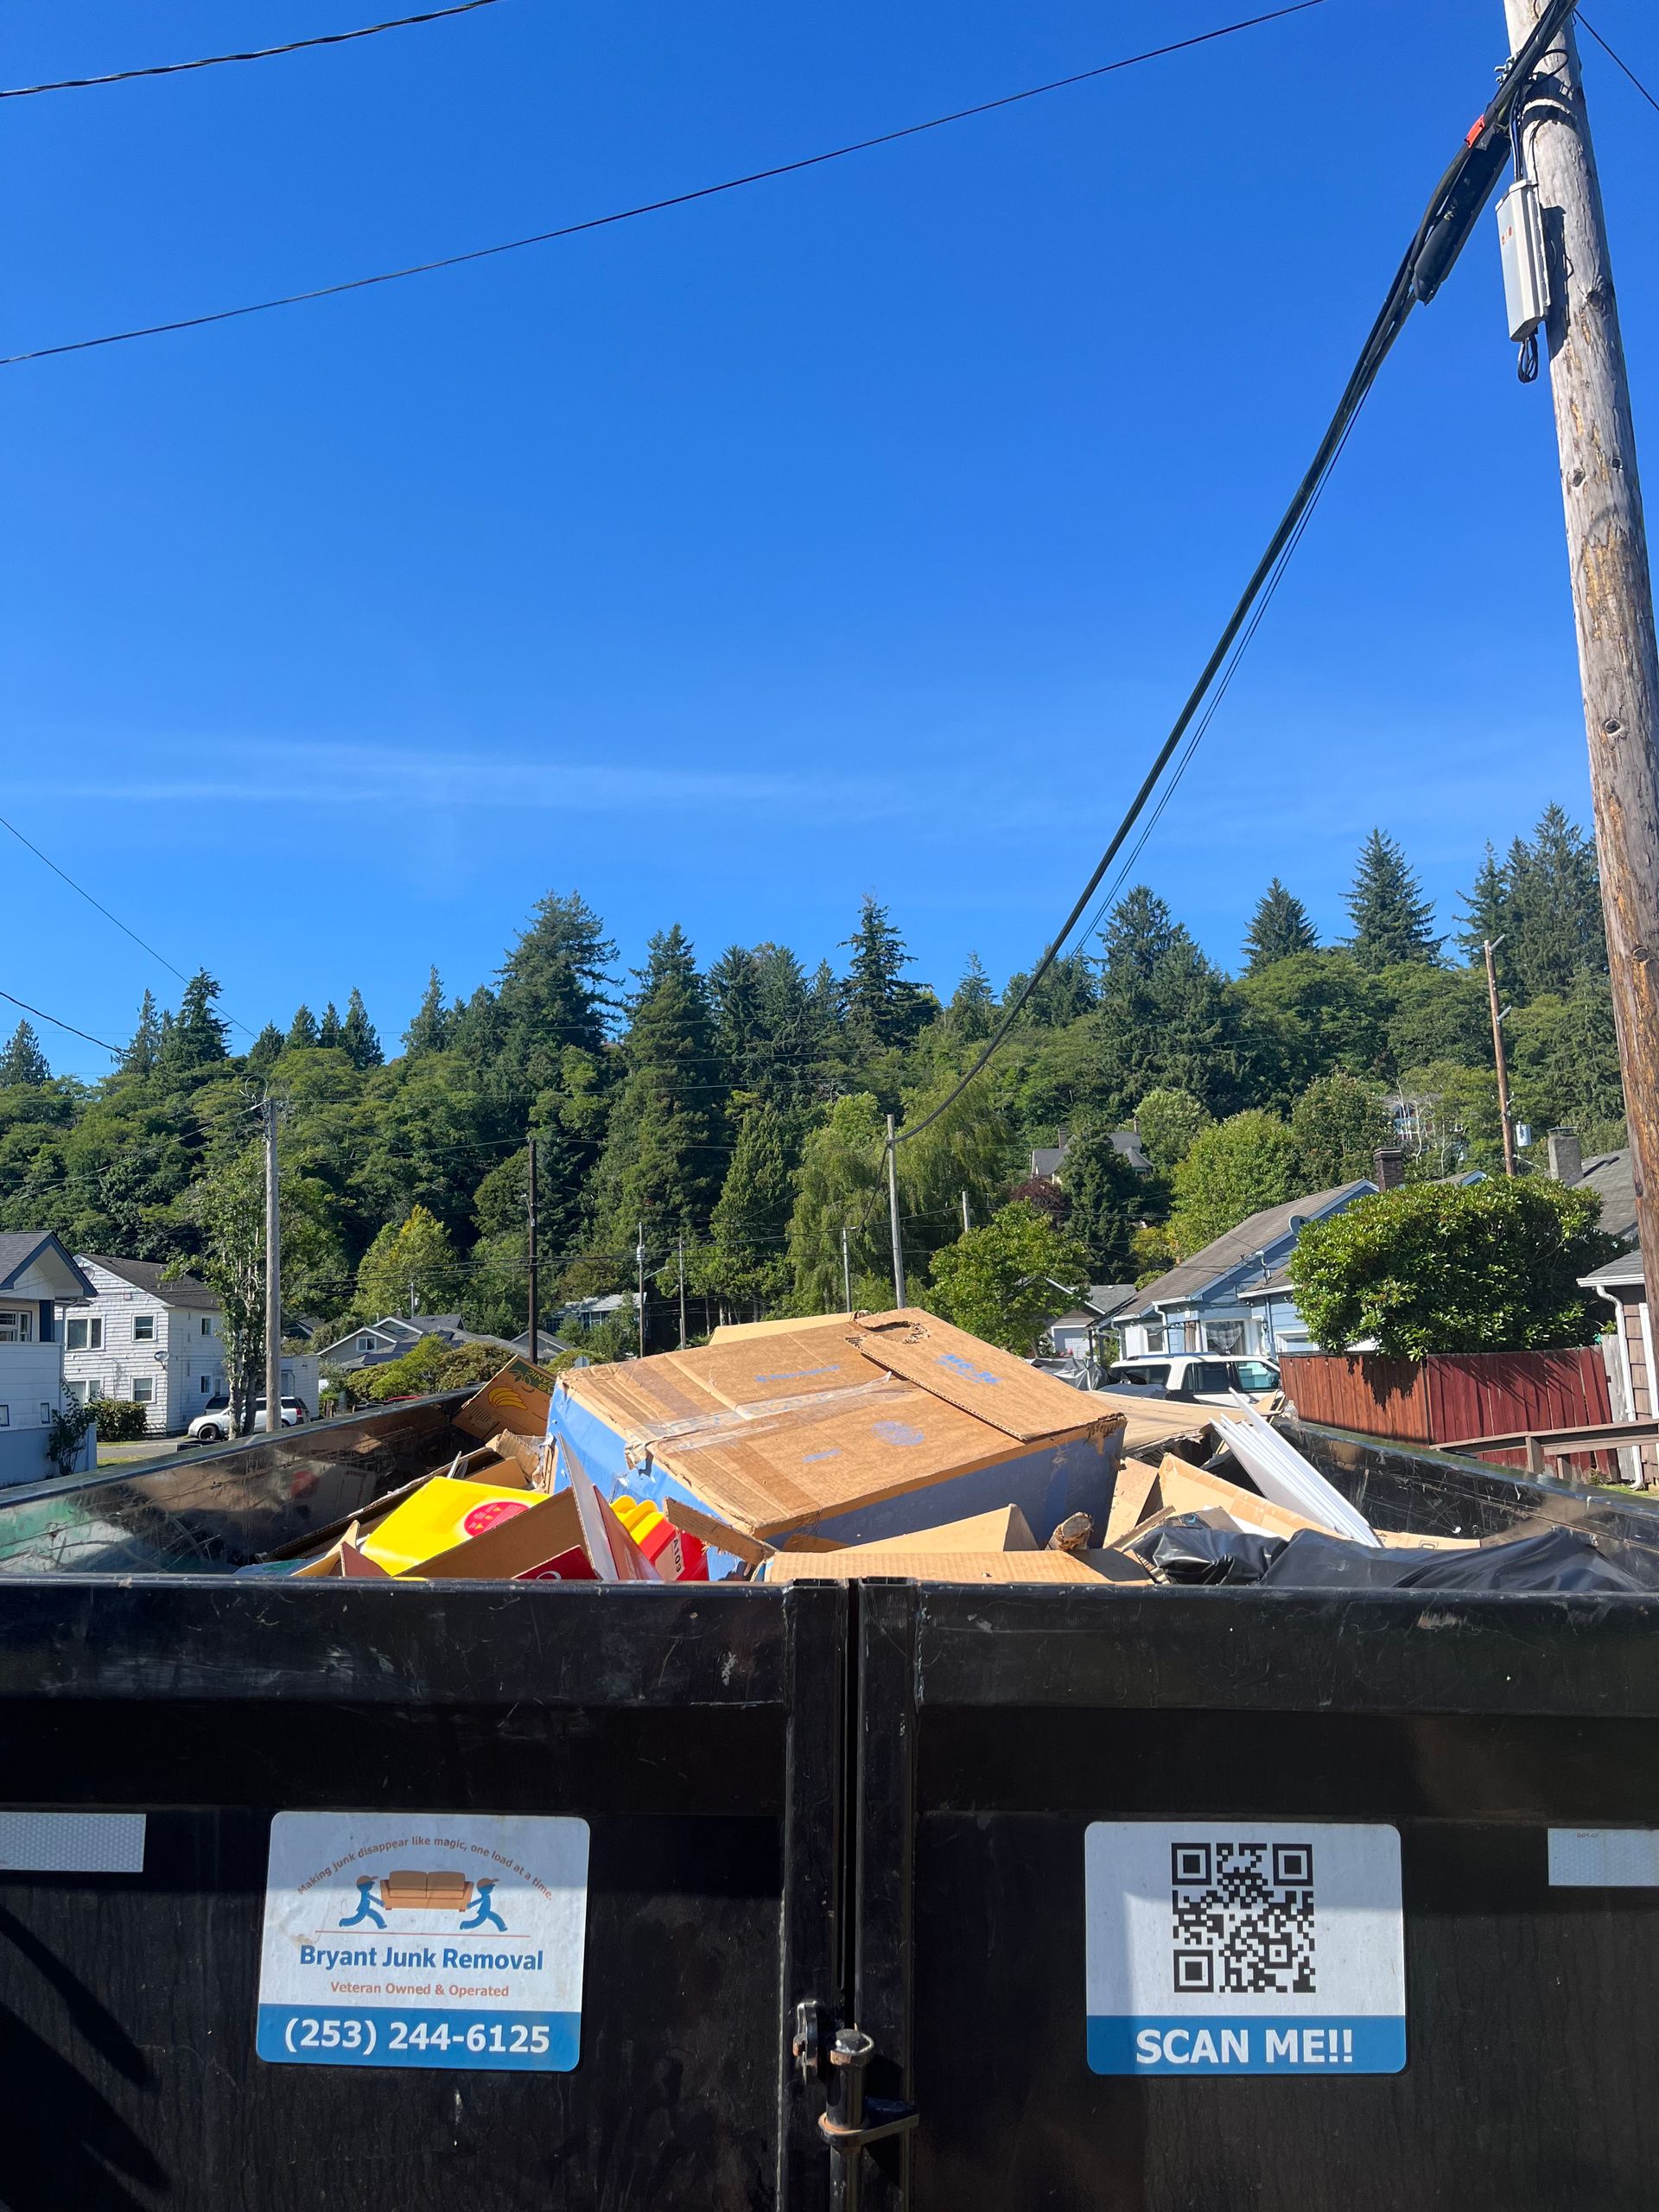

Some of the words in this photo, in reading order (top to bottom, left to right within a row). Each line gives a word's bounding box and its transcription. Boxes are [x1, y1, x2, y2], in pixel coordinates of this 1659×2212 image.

[297, 1866, 332, 1895] Making
[332, 1852, 356, 1872] junk
[358, 1839, 409, 1859] disappear
[412, 1836, 431, 1846] like
[434, 1837, 467, 1852] magic,
[470, 1845, 490, 1857] one
[491, 1851, 513, 1868] load
[513, 1865, 525, 1876] at
[532, 1877, 553, 1901] time.
[300, 1944, 377, 1970] Bryant
[382, 1947, 436, 1968] Junk
[442, 1948, 543, 1970] Removal
[331, 1981, 381, 1994] Veteran
[385, 1982, 431, 1995] Owned
[435, 1985, 445, 1996] &
[448, 1985, 510, 1998] Operated
[284, 2018, 377, 2055] (253)
[389, 2022, 550, 2054] 244-6125
[1136, 2029, 1249, 2064] SCAN
[1265, 2029, 1354, 2063] ME!!
